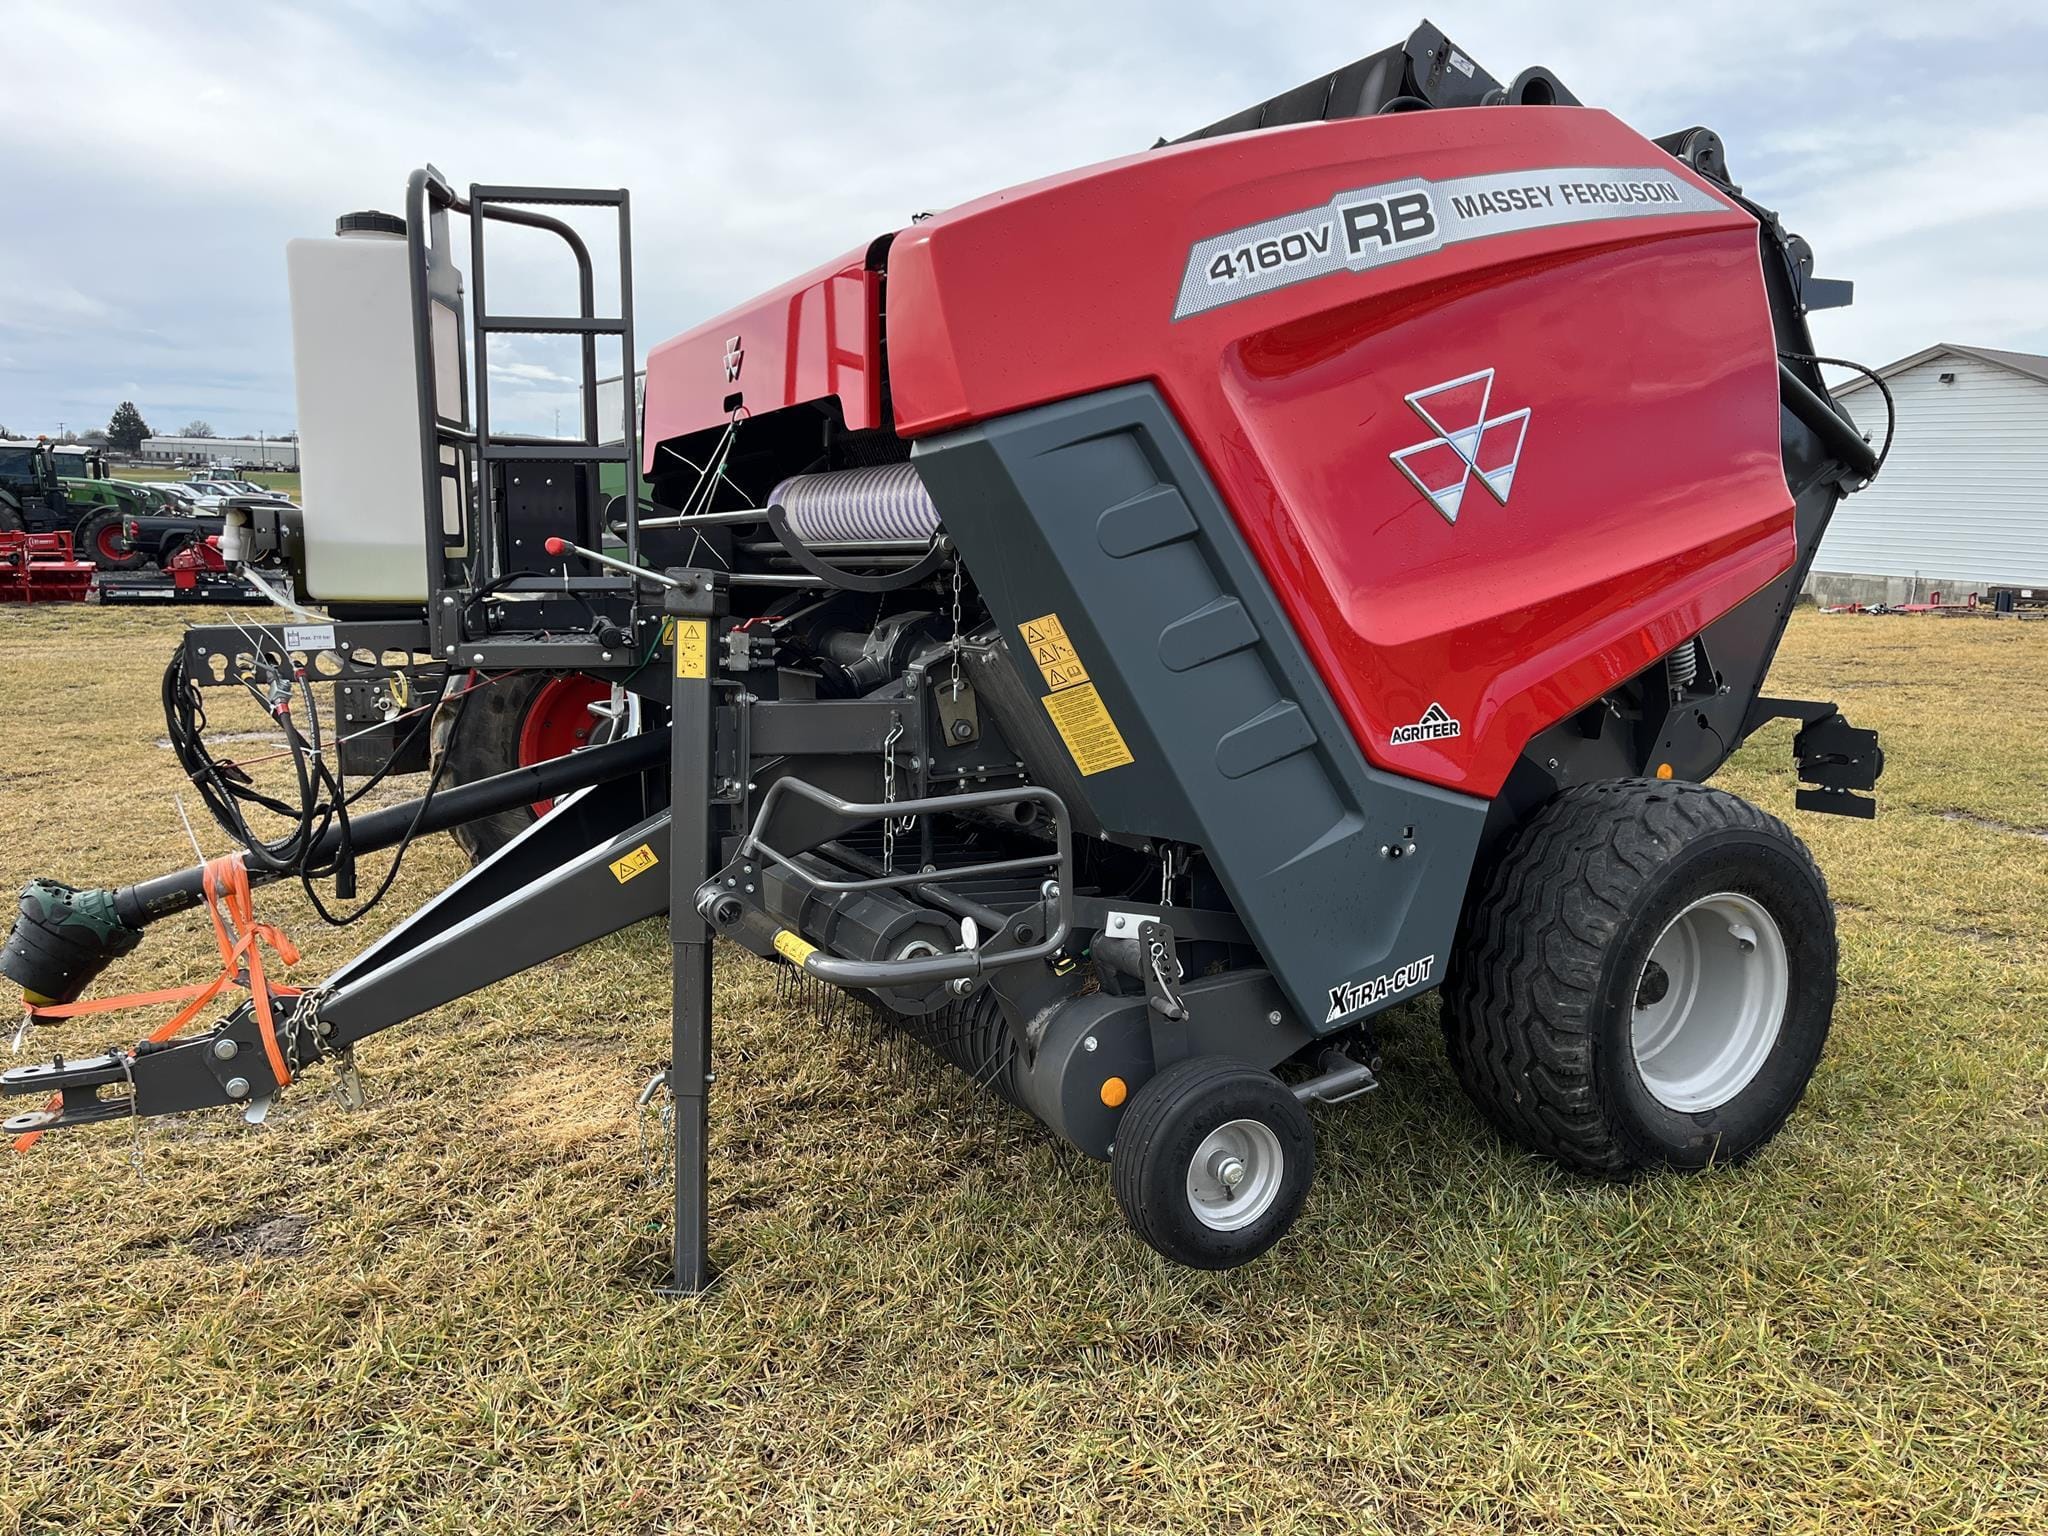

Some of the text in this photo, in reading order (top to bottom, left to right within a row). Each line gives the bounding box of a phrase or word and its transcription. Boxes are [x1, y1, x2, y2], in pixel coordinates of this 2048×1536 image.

[1209, 181, 1680, 281] 4160V RB MASSEY FERGUSON
[1391, 721, 1459, 744] AGRITEER
[1326, 955, 1434, 1023] XTRA-CUT
